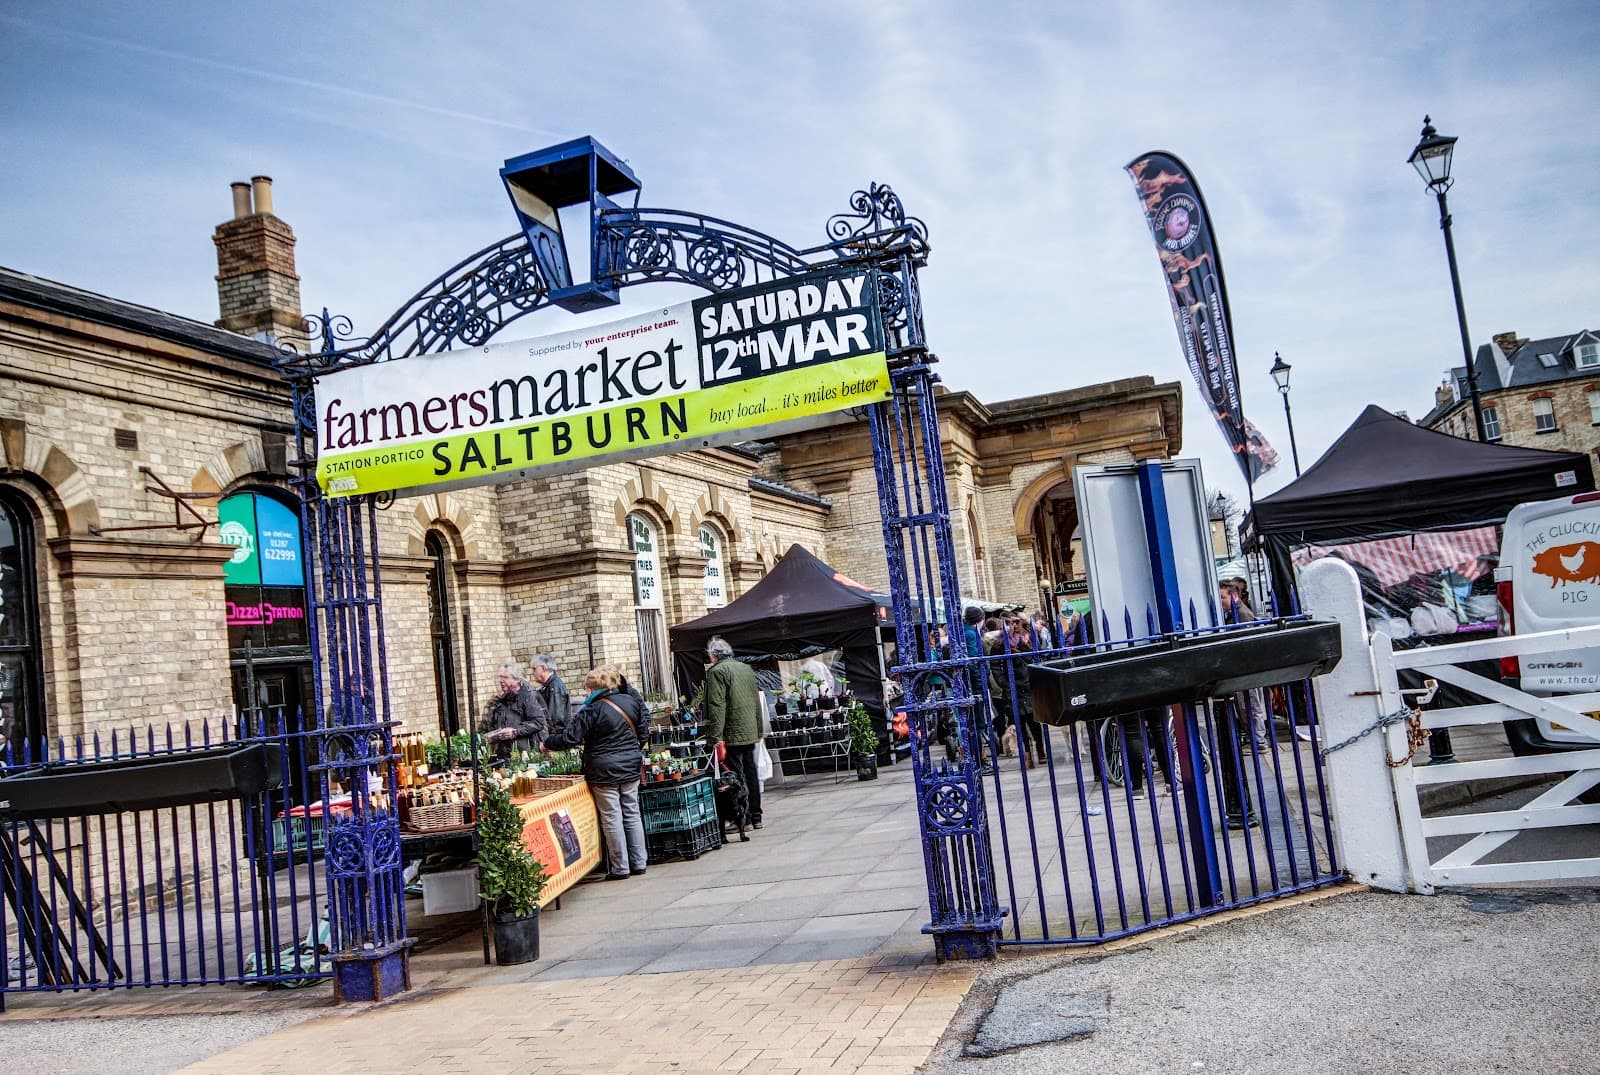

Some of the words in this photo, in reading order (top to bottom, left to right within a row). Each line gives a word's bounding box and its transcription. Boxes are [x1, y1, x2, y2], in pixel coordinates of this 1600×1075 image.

[700, 275, 866, 339] SATURDAY
[528, 341, 571, 357] Supported
[572, 339, 583, 351] by
[584, 335, 606, 347] your
[606, 324, 653, 342] enterprise
[654, 318, 679, 331] team.
[757, 313, 871, 371] MAR
[323, 337, 688, 451] farmersmarket
[709, 407, 735, 425] buy
[737, 397, 779, 418] local...
[803, 385, 838, 405] miles
[841, 377, 880, 397] better
[326, 456, 372, 474] STATION
[375, 449, 425, 466] PORTICO
[431, 397, 689, 477] SALTBURN
[264, 549, 296, 561] 622999
[1526, 532, 1547, 553] THE
[1562, 590, 1588, 604] PIG
